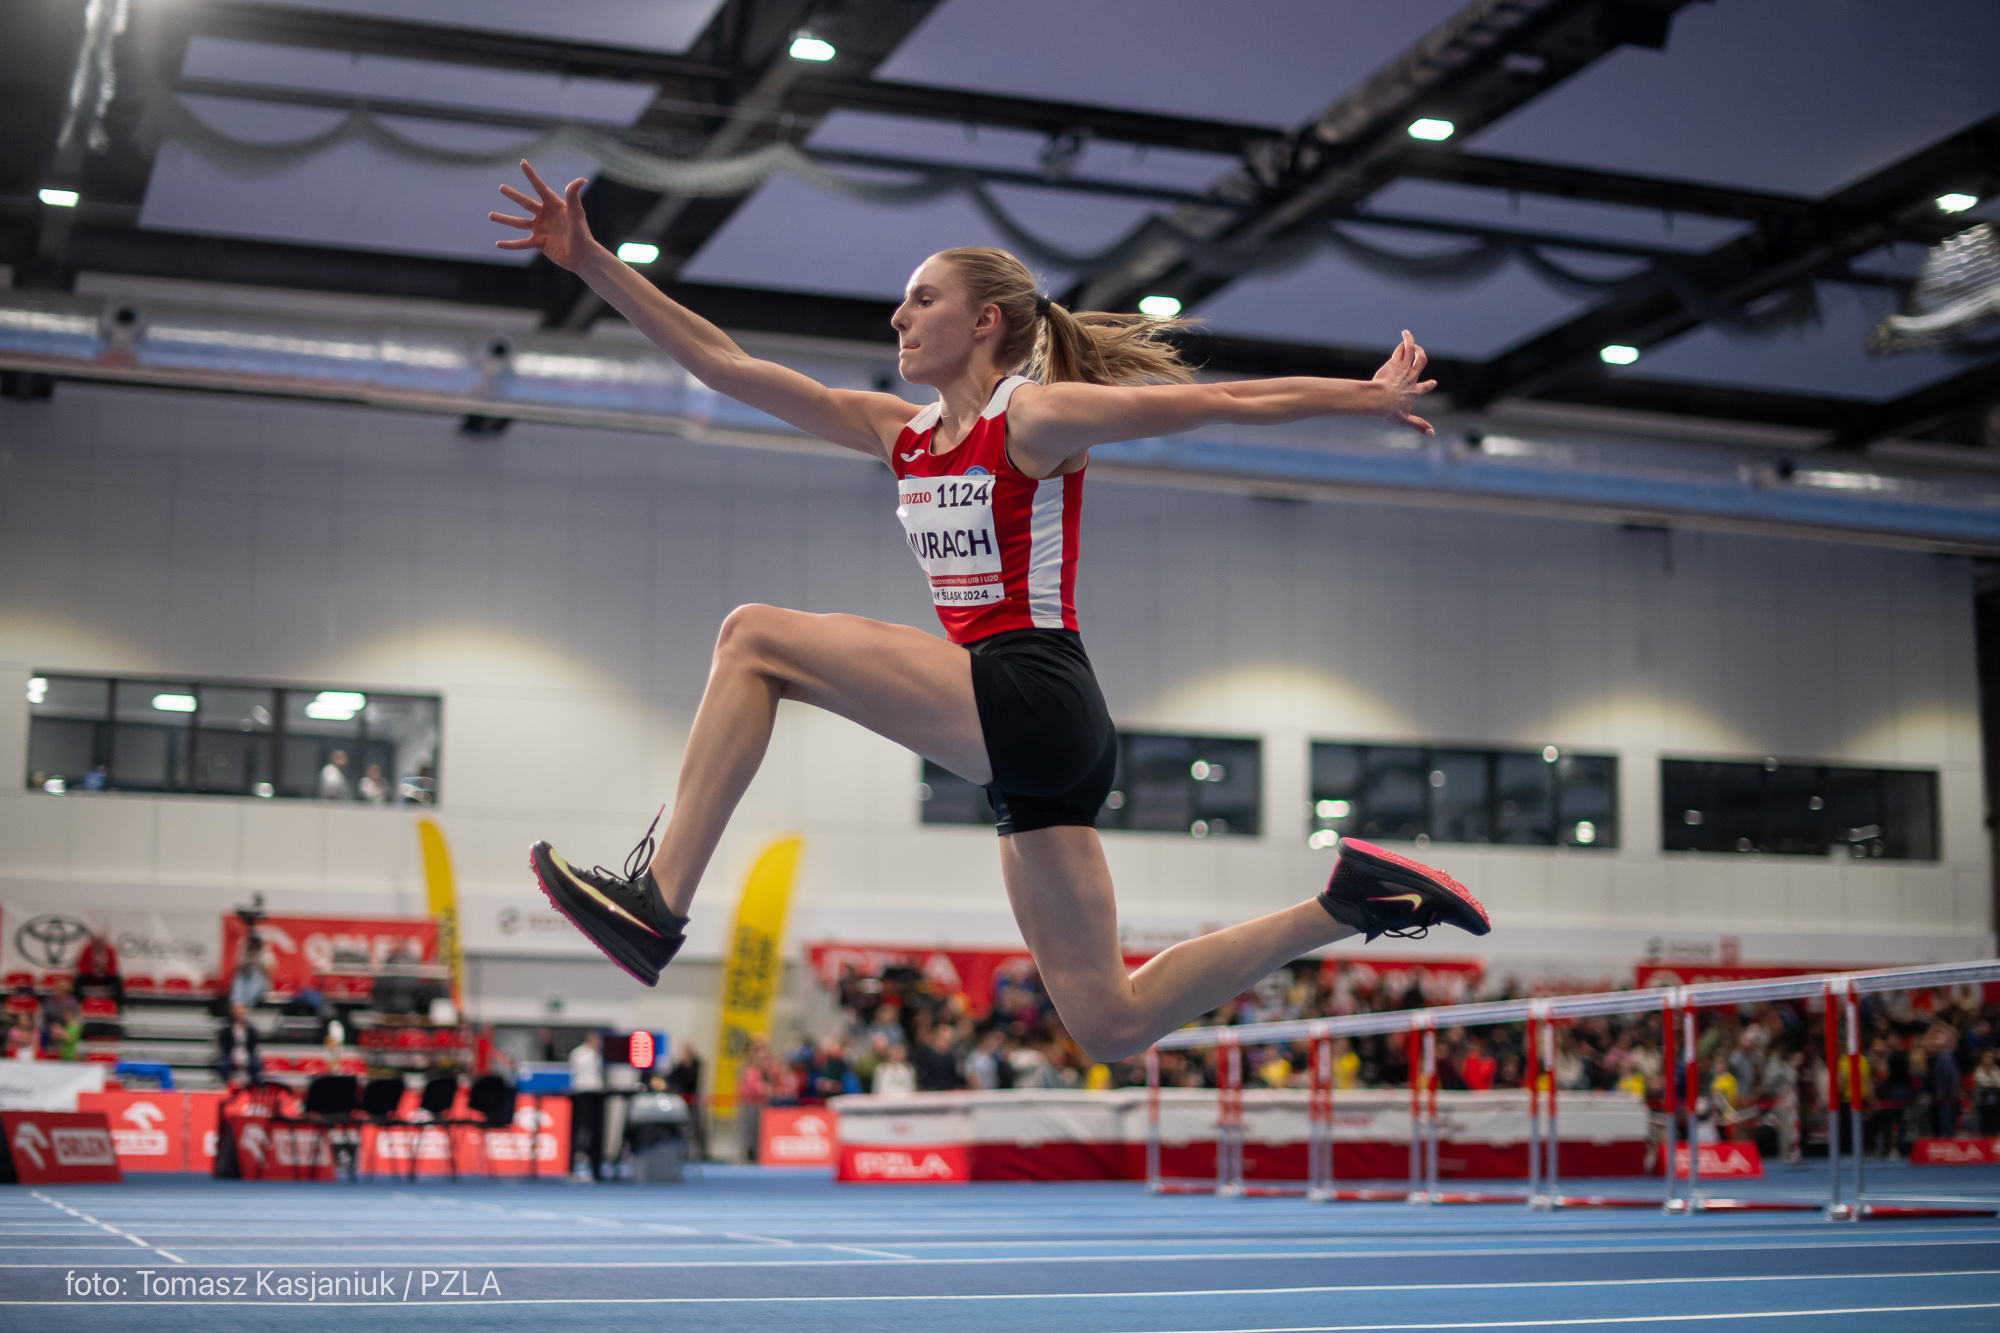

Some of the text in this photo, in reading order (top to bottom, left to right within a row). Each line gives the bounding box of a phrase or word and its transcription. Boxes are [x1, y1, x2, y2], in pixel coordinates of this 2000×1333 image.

[900, 480, 989, 508] ODZIO 1124
[968, 576, 979, 584] U18
[984, 574, 999, 583] U20
[941, 588, 962, 603] ŚLĄSK
[963, 589, 989, 600] 2024
